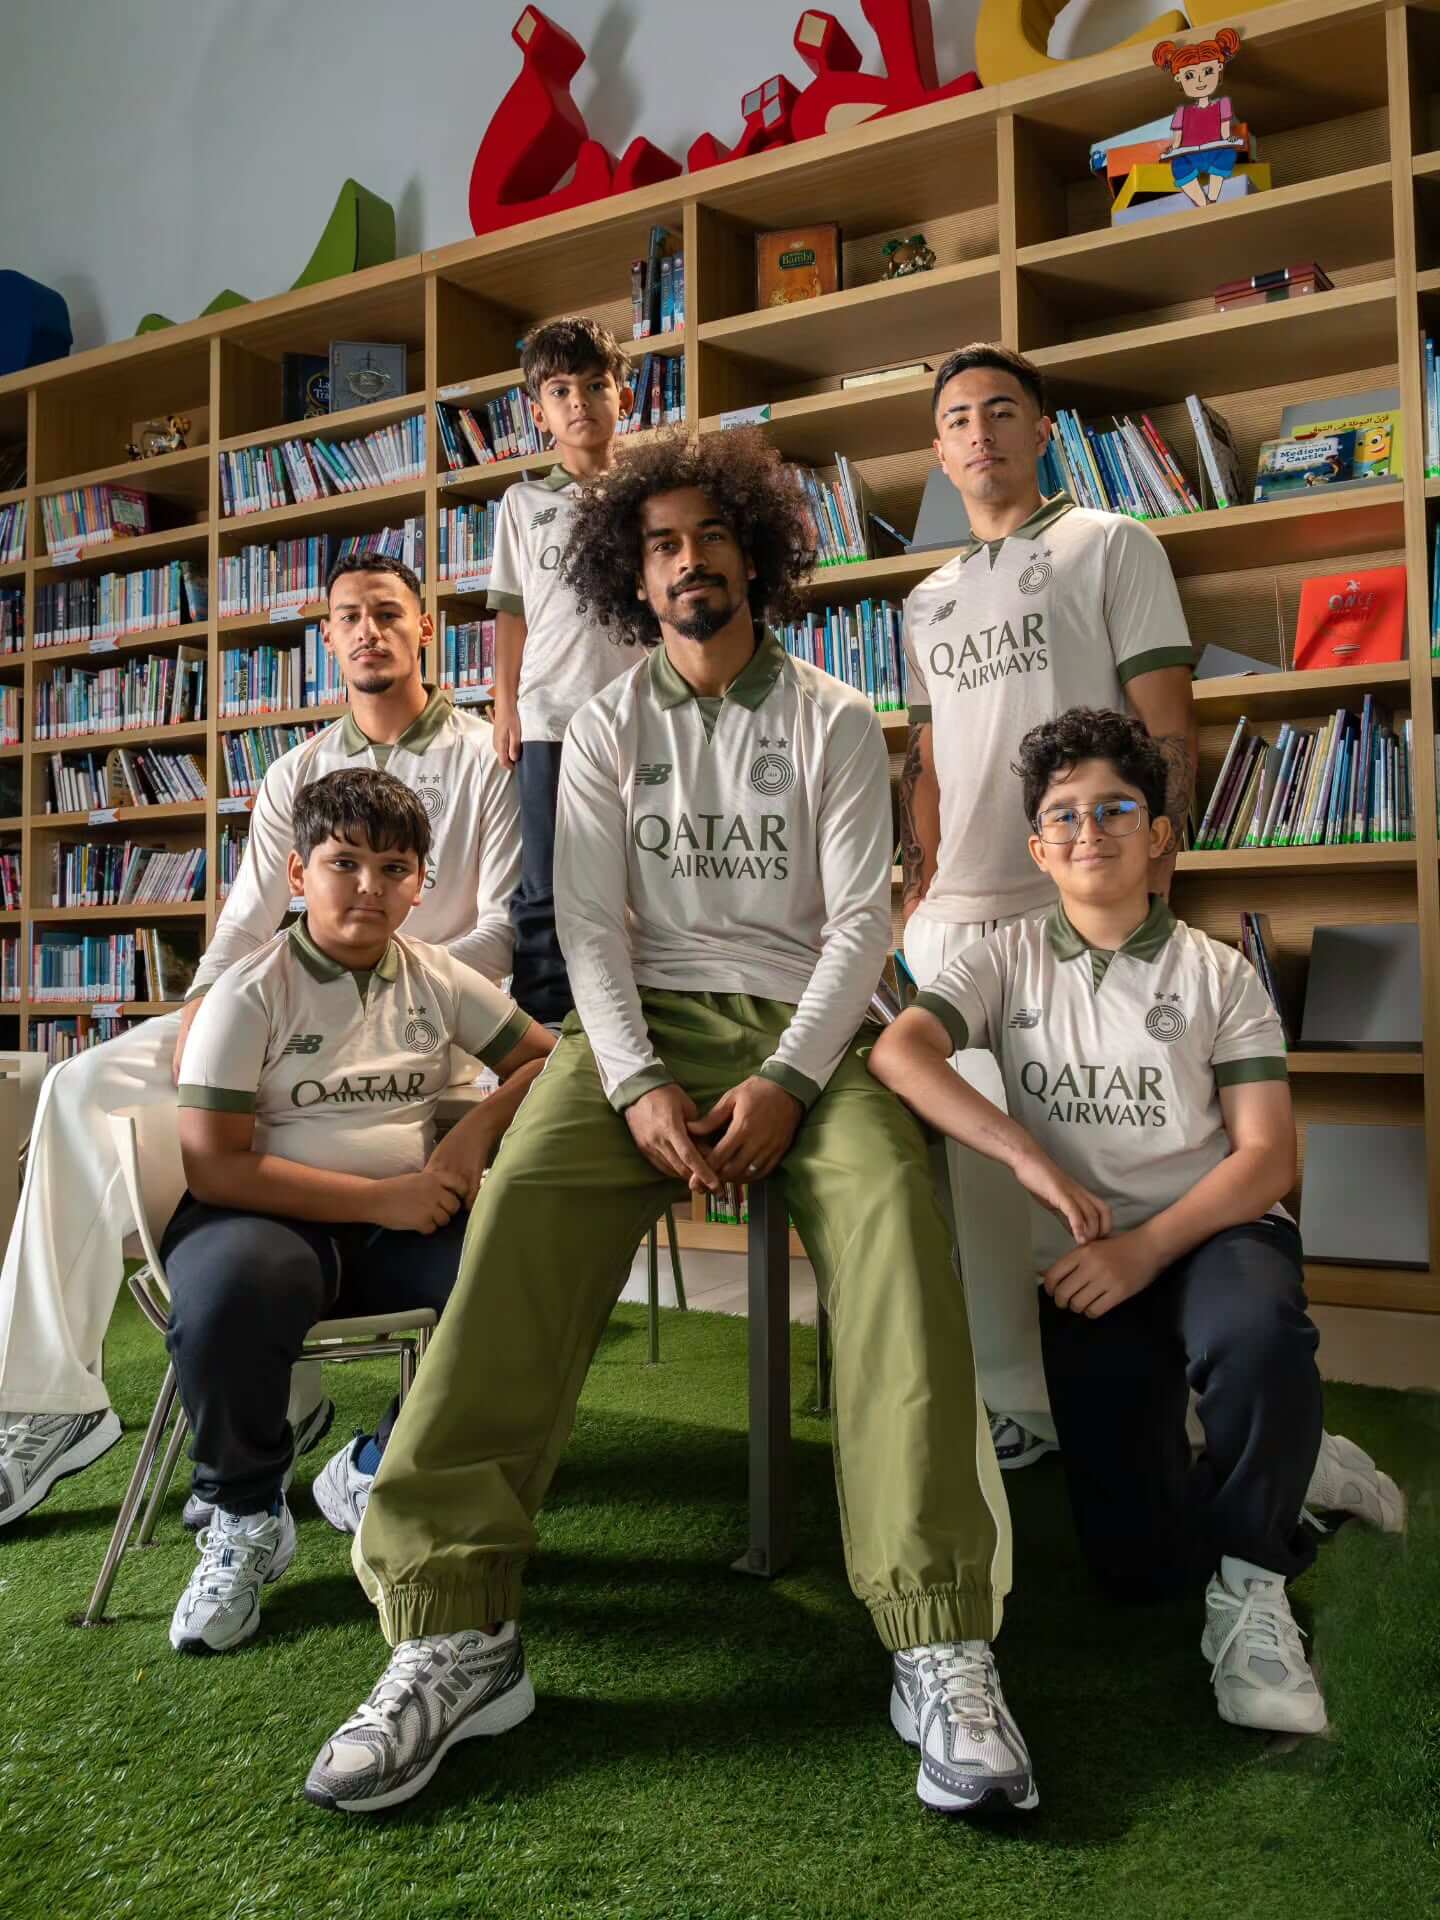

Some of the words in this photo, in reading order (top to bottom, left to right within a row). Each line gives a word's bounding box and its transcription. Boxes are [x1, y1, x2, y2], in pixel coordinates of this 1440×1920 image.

[782, 248, 813, 265] Bambi
[1279, 445, 1332, 459] Medieval
[929, 612, 1047, 679] QATAR
[957, 648, 1048, 693] AIRWAYS
[634, 812, 789, 861] QATAR
[671, 854, 789, 880] AIRWAYS
[1020, 1060, 1166, 1104] QATAR
[1048, 1101, 1167, 1128] AIRWAYS
